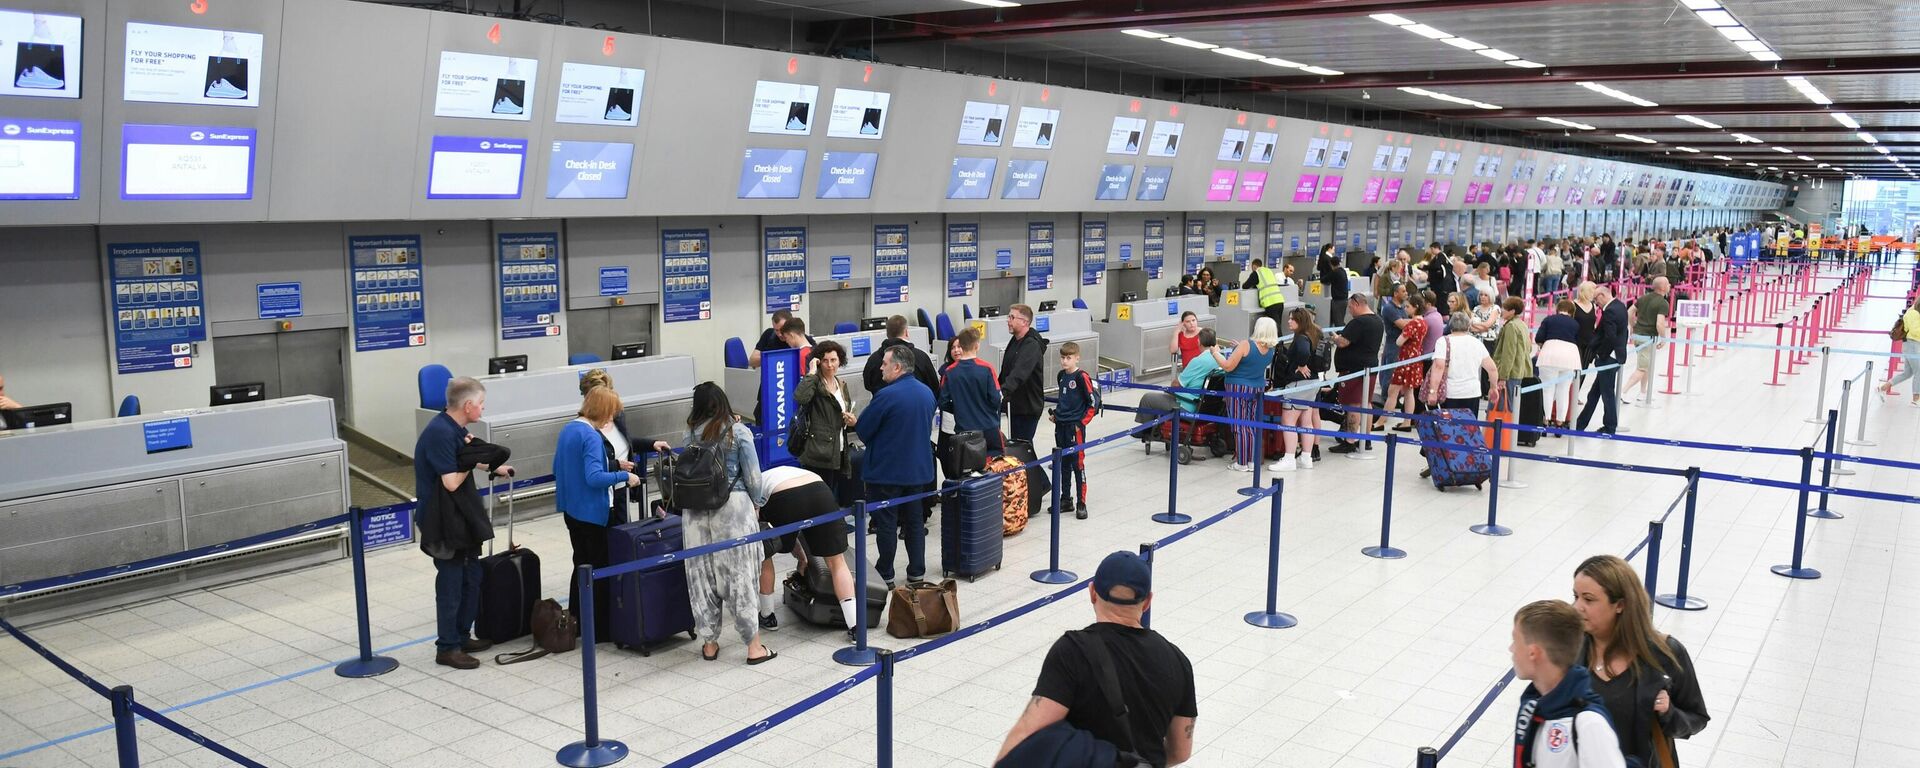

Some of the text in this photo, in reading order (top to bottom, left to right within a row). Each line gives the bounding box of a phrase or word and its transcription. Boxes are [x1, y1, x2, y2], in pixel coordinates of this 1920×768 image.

[487, 23, 502, 44] 4
[602, 36, 615, 56] 5
[164, 52, 196, 60] SHOPPING
[788, 57, 798, 74] 6
[864, 65, 872, 82] 7
[26, 126, 74, 136] SunExpress
[209, 132, 249, 141] SunExpress
[565, 160, 616, 170] Check-in Desk
[754, 164, 793, 174] Check-in Desk
[830, 167, 852, 175] Check-in
[577, 172, 602, 181] Closed
[762, 175, 782, 183] Closed
[837, 176, 855, 184] Closed
[776, 360, 785, 436] RYANAIR
[370, 513, 396, 522] NOTICE
[1516, 700, 1538, 739] JOM
